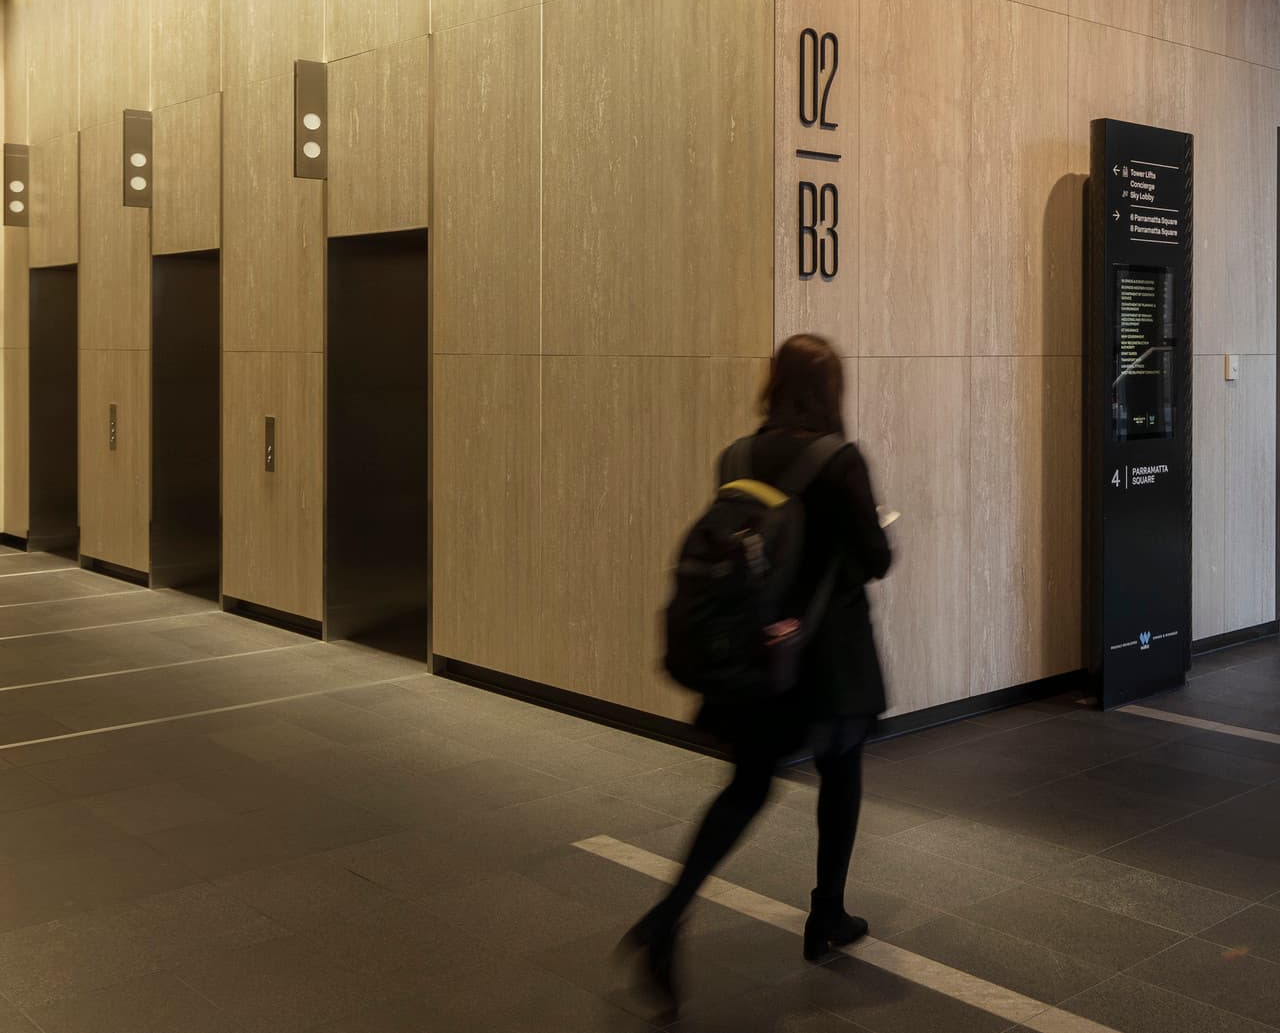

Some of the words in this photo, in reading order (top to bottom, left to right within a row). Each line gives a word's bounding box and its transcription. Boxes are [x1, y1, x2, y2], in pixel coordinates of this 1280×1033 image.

[799, 27, 839, 131] 02
[1130, 168, 1145, 178] Tower
[1145, 170, 1156, 179] Lifts
[1130, 180, 1155, 191] Concierge
[1130, 191, 1139, 201] Sky
[1140, 192, 1155, 202] Lobby
[1134, 213, 1161, 224] Parramatta
[1161, 216, 1178, 226] Square
[799, 180, 839, 282] B3
[1134, 225, 1161, 235] Parramatta
[1161, 227, 1178, 237] Square
[1132, 464, 1169, 476] PARRAMATTA
[1111, 469, 1121, 487] 4
[1132, 474, 1156, 485] SQUARE
